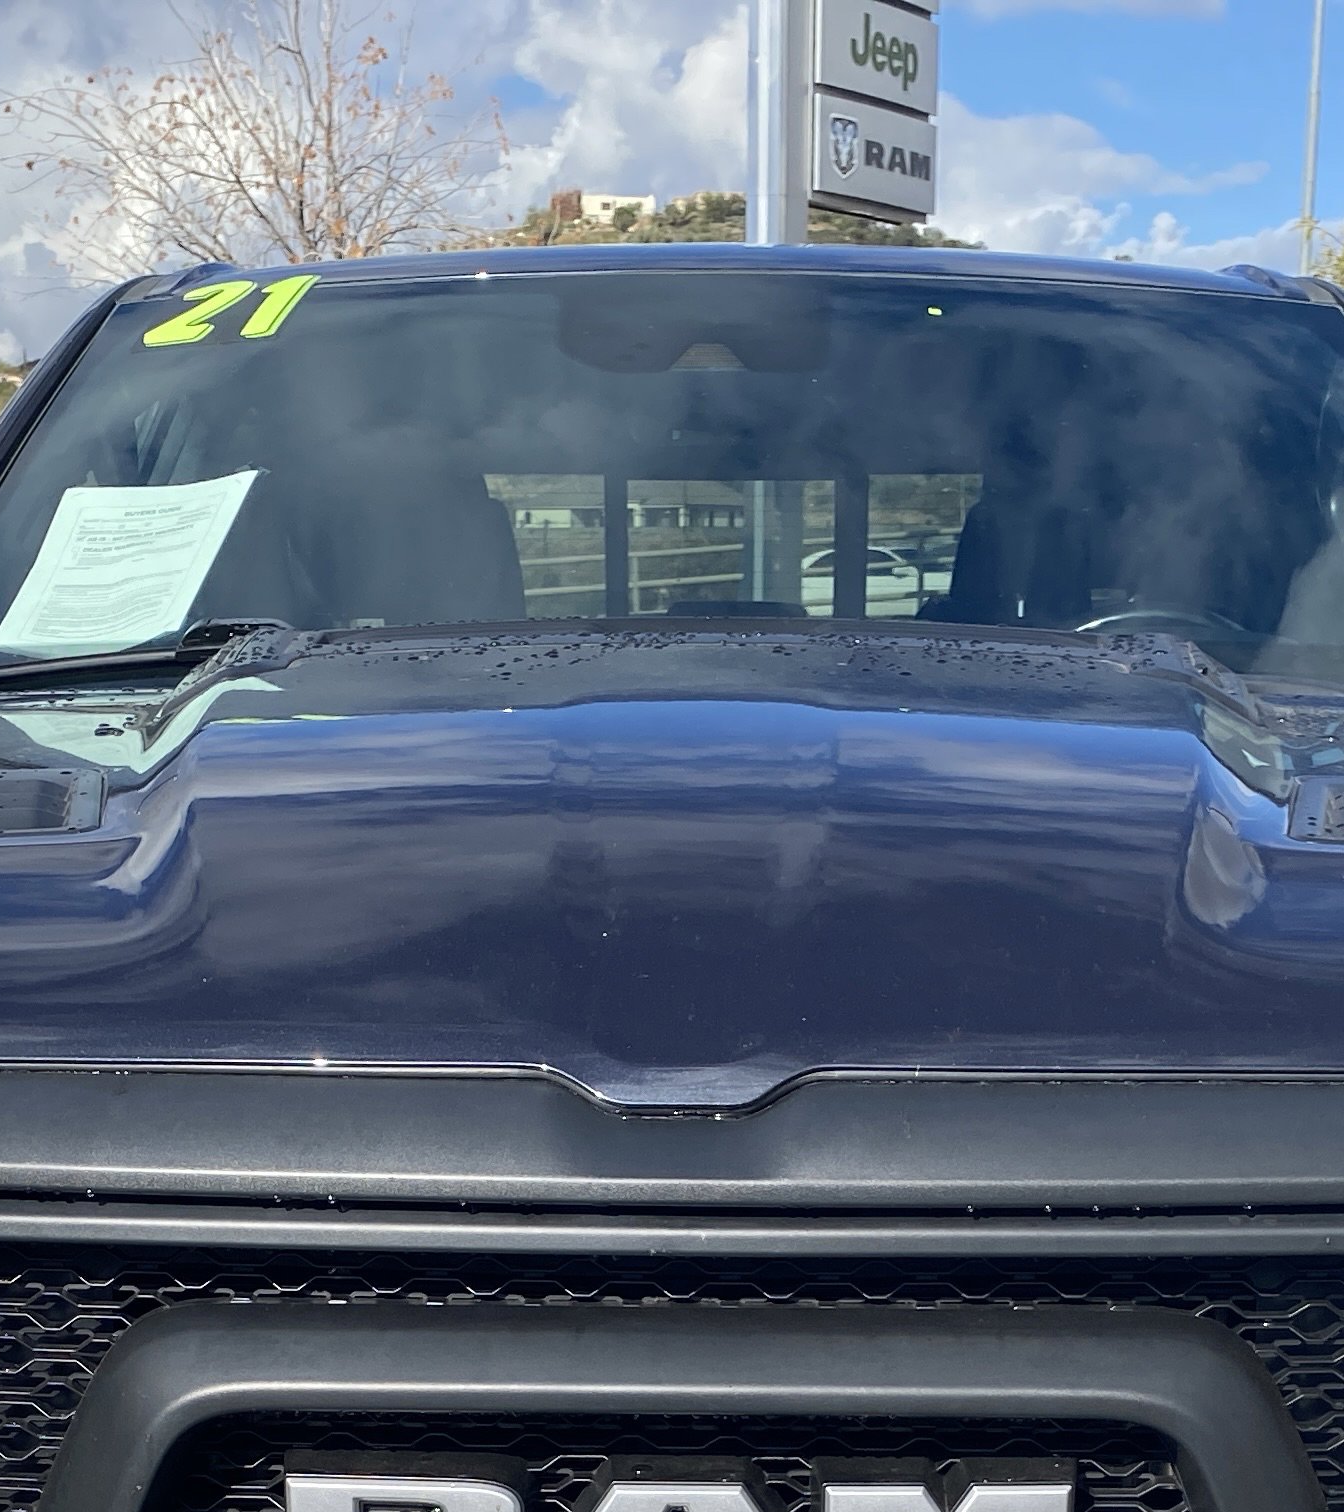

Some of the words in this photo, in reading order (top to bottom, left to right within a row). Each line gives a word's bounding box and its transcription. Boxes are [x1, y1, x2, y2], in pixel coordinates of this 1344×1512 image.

[851, 12, 918, 91] Jeep
[864, 139, 931, 181] RAM
[143, 274, 322, 347] 21
